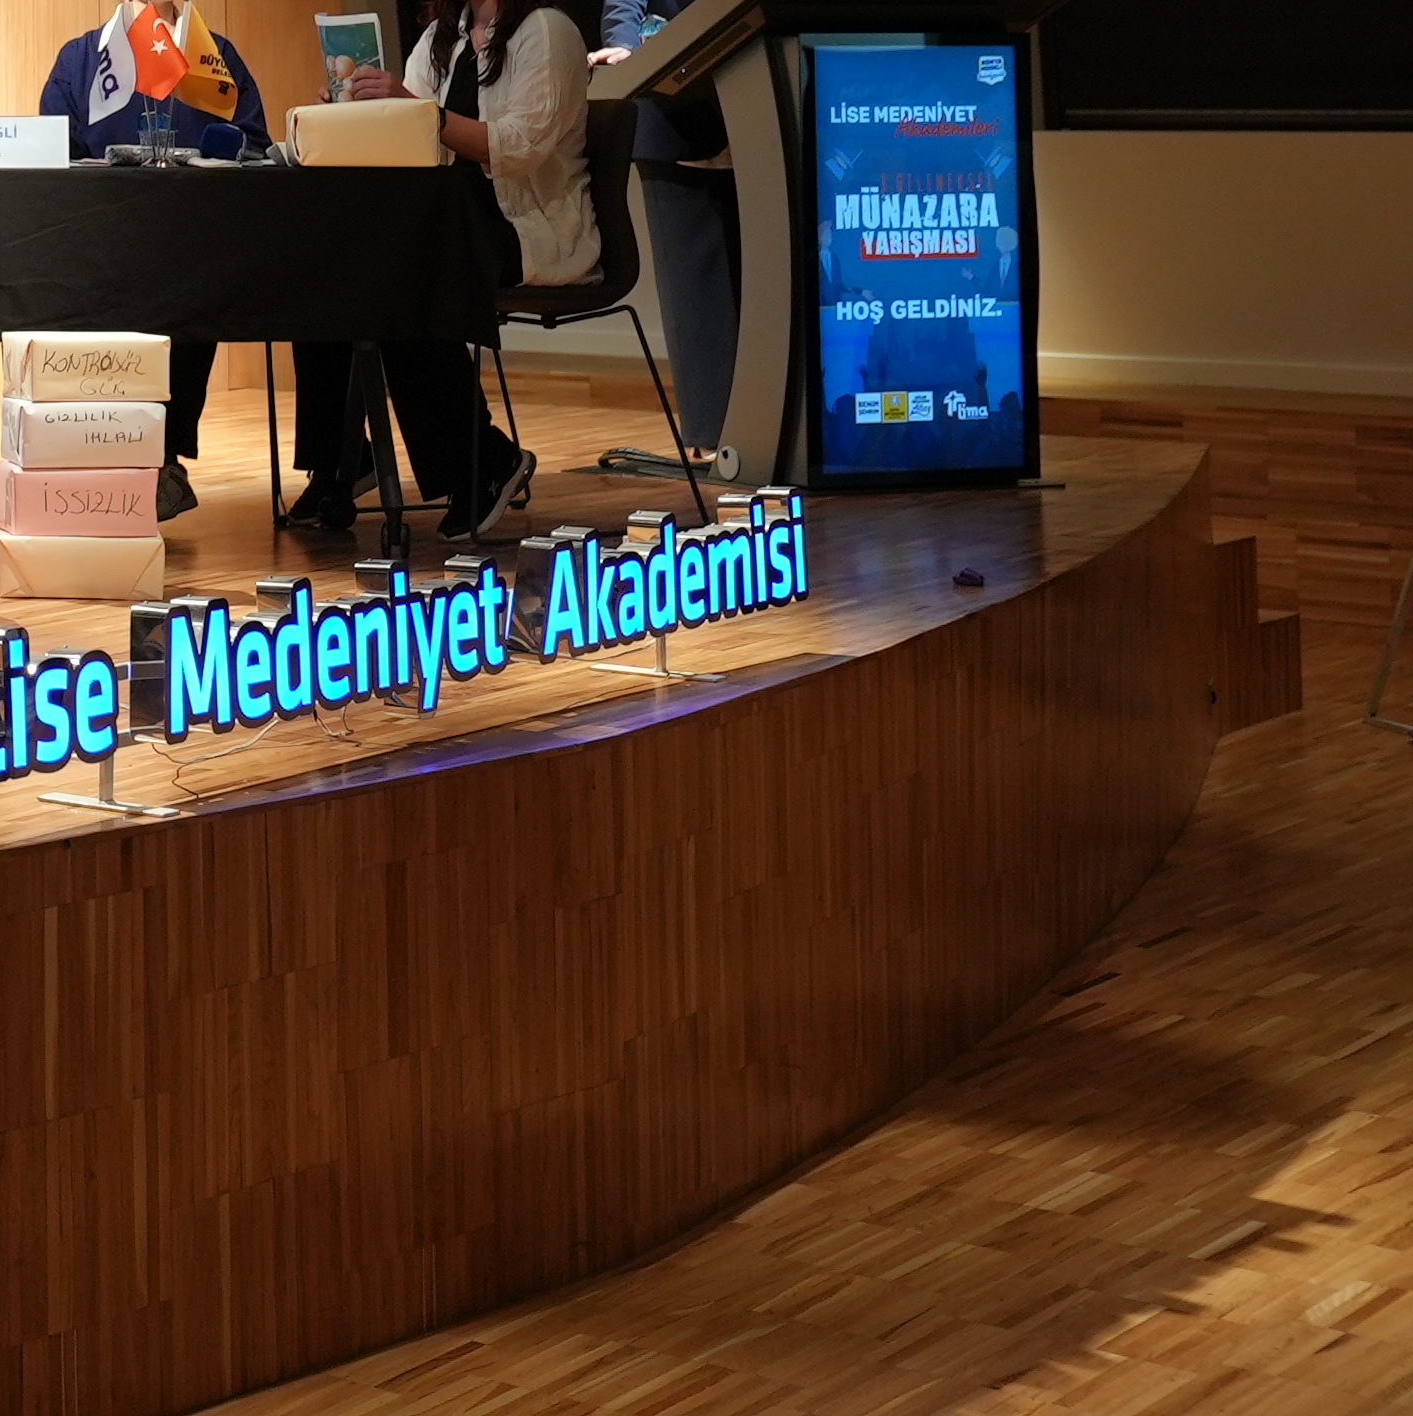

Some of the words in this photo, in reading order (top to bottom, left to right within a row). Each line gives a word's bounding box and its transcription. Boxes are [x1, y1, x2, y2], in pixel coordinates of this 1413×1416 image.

[830, 101, 871, 124] LİSE
[874, 100, 978, 124] MEDENİYET
[834, 186, 1000, 230] MÜNAZARA
[862, 229, 977, 259] YARIŞMASI
[836, 300, 885, 325] HOŞ
[890, 293, 1003, 320] GELDİNİZ.
[84, 425, 143, 444] İHLALİ
[43, 482, 146, 517] İŞSİZLİK
[167, 566, 507, 738] Medeniyet
[541, 494, 809, 657] Akademisi
